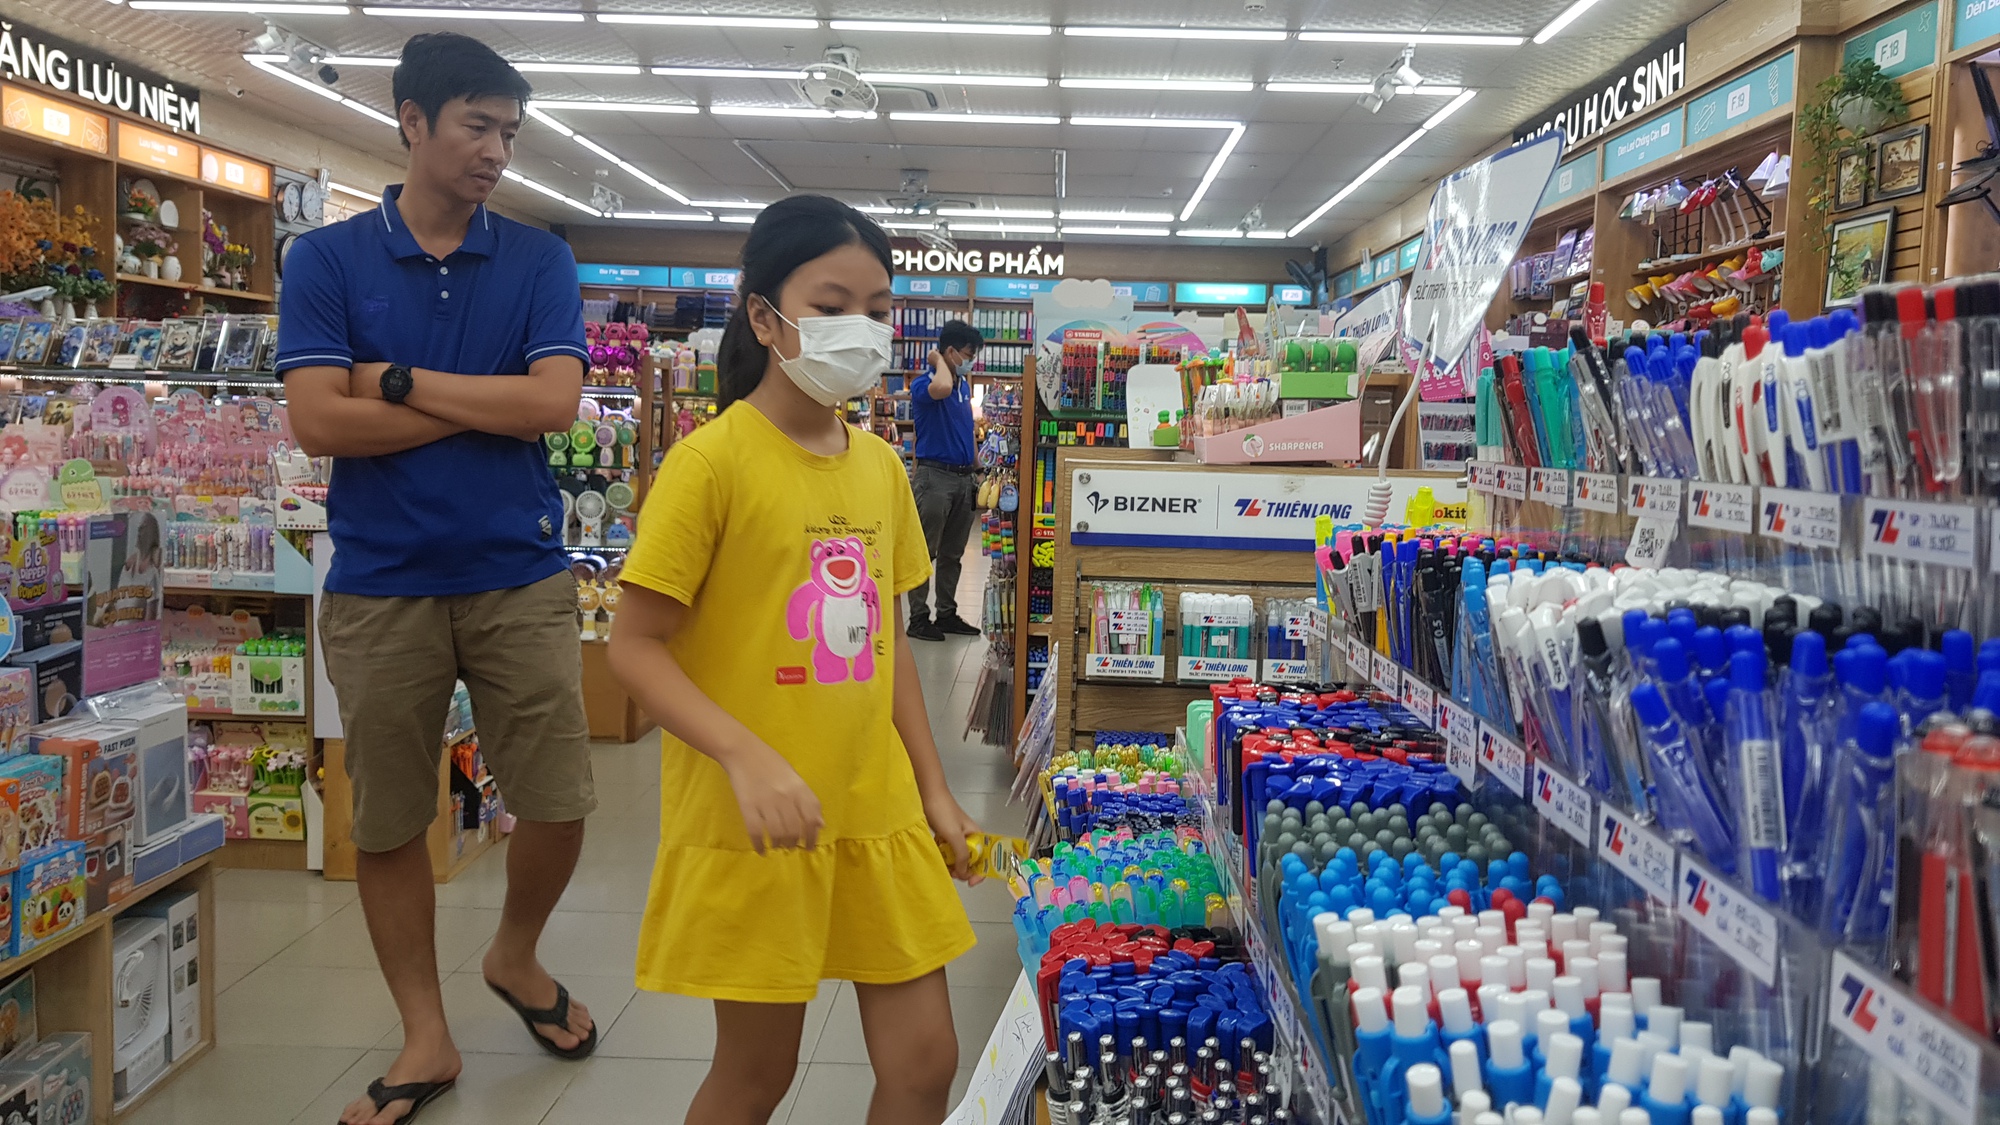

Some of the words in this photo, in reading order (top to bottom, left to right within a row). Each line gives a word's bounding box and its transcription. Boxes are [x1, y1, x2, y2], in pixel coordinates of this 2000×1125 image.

[1880, 39, 1899, 62] F.18
[77, 59, 132, 111] LƯU
[139, 82, 200, 134] NIỆM
[1583, 76, 1627, 135] HỌC
[1632, 42, 1684, 112] SINH
[1731, 91, 1745, 111] F.19
[989, 245, 1064, 275] PHẨM
[1114, 496, 1198, 514] BIZNER
[1433, 507, 1466, 519] okit
[24, 542, 43, 566] BIG
[20, 565, 47, 580] DIPPER
[1432, 620, 1444, 638] 0.5
[1112, 658, 1133, 668] THIÊN
[1134, 660, 1155, 669] LONG
[1204, 661, 1227, 671] THIÊN
[1228, 663, 1248, 673] LONG
[104, 741, 118, 754] FAST
[119, 736, 136, 748] PUSH
